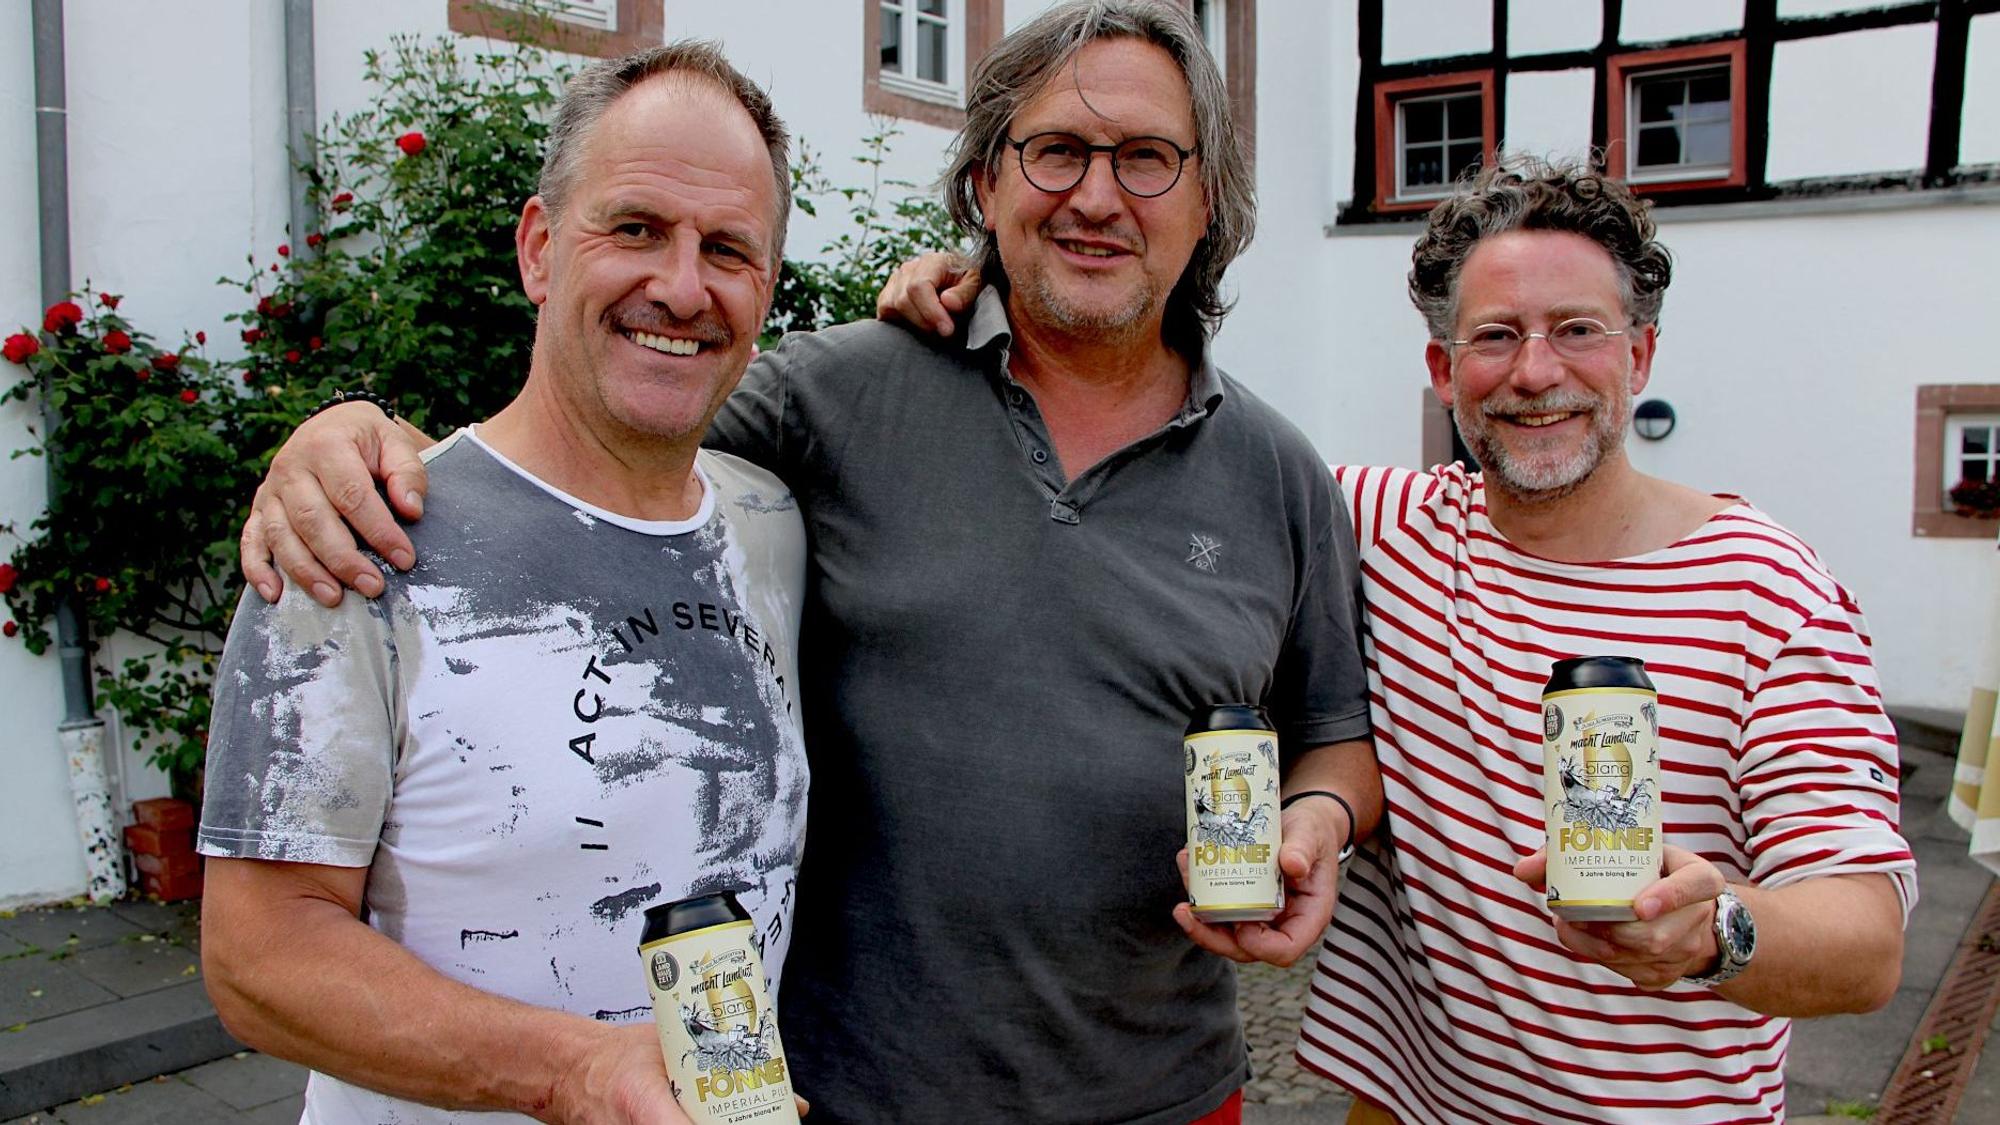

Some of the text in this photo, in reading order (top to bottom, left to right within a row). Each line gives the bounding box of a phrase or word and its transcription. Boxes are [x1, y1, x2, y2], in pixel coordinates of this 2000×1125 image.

[569, 655, 612, 765] ACT
[611, 607, 659, 654] IN
[1600, 730, 1640, 749] Landlust
[1564, 855, 1651, 865] IMPERIAL PILS
[1199, 867, 1269, 877] IMPERIAL PILS
[707, 1086, 789, 1115] IMPERIAL PILS
